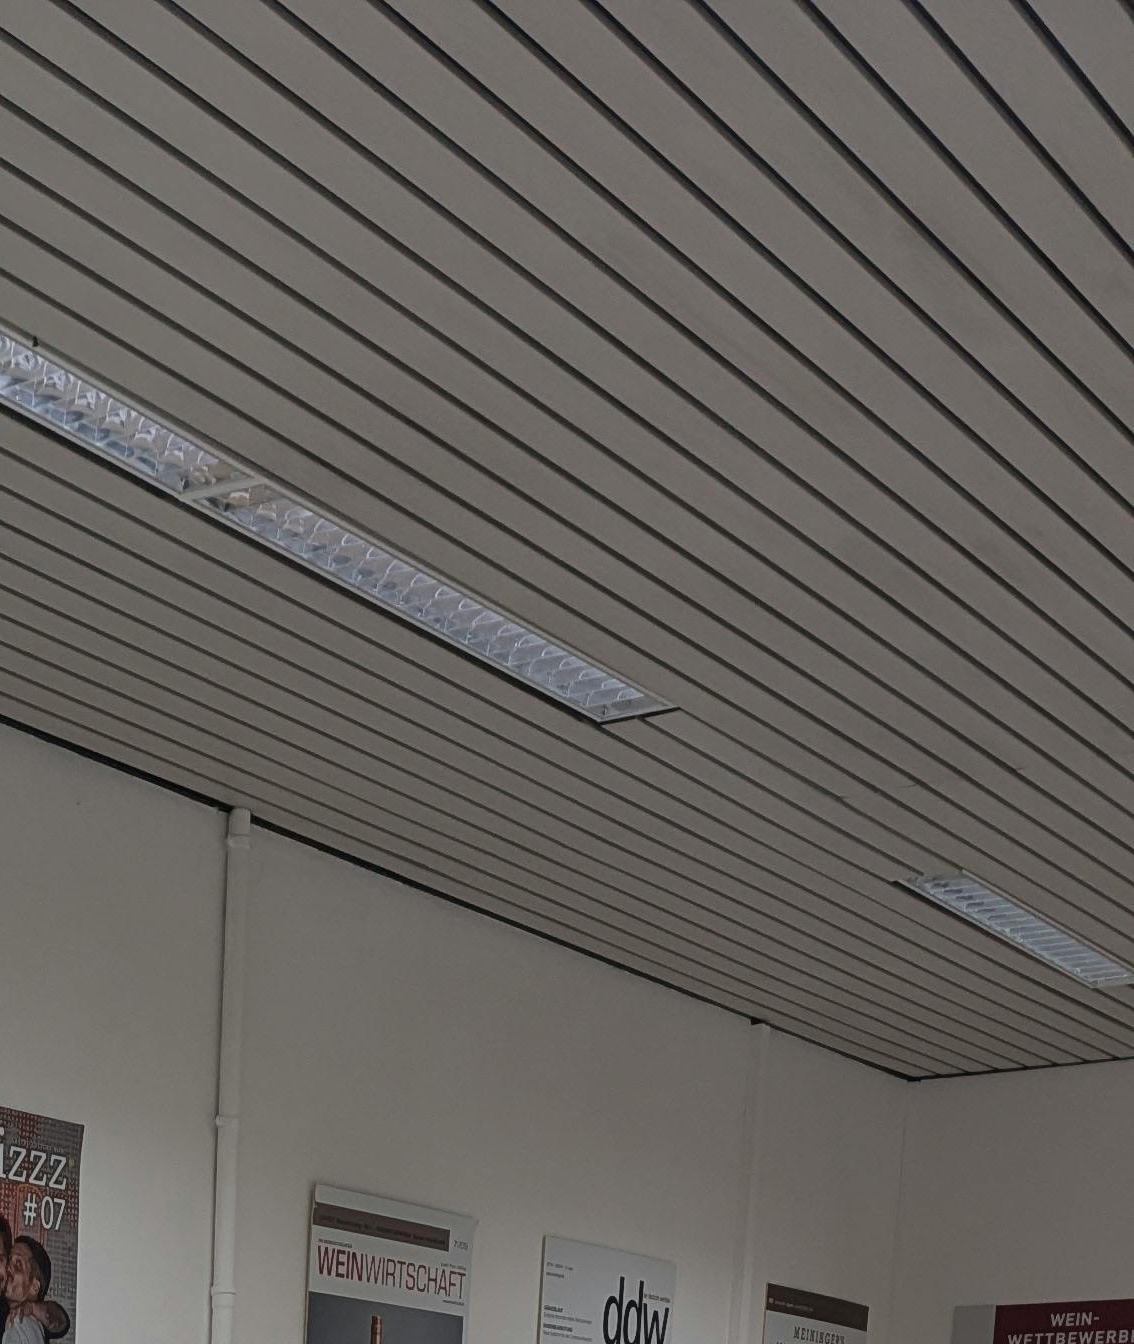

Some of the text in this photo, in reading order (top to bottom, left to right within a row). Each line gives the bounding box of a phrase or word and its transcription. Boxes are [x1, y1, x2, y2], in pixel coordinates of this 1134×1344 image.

[23, 1193, 66, 1231] #07
[317, 1245, 466, 1299] WEINWIRTSCHAFT
[1050, 1312, 1100, 1327] WEIN-
